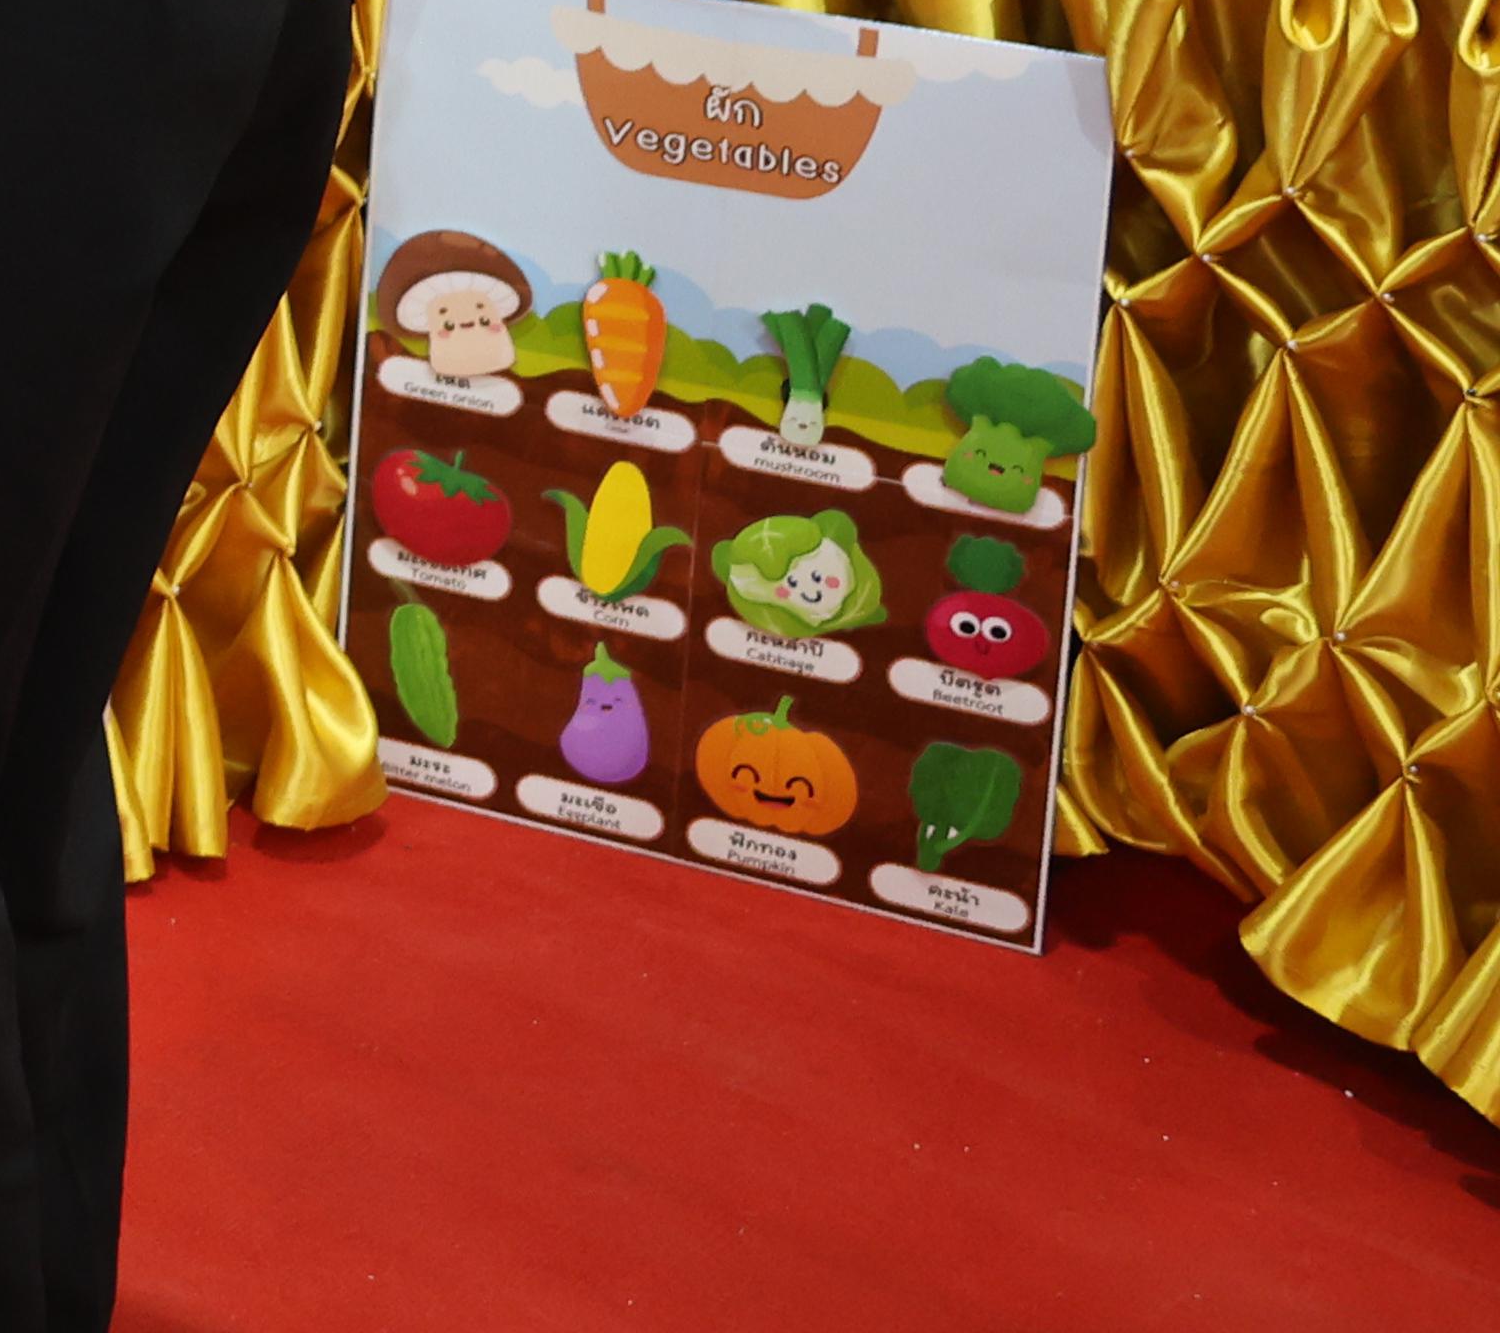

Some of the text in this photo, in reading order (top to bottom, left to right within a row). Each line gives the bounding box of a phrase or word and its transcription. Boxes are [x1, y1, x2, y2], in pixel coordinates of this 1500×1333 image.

[703, 85, 763, 128] ผัก
[603, 116, 840, 185] Vegetables
[754, 456, 840, 483] mushroom
[411, 568, 466, 590] Tomato
[594, 609, 629, 627] Corn
[746, 647, 814, 674] Cabbage
[932, 689, 1004, 715] Beetroot
[933, 902, 969, 917] Kale
